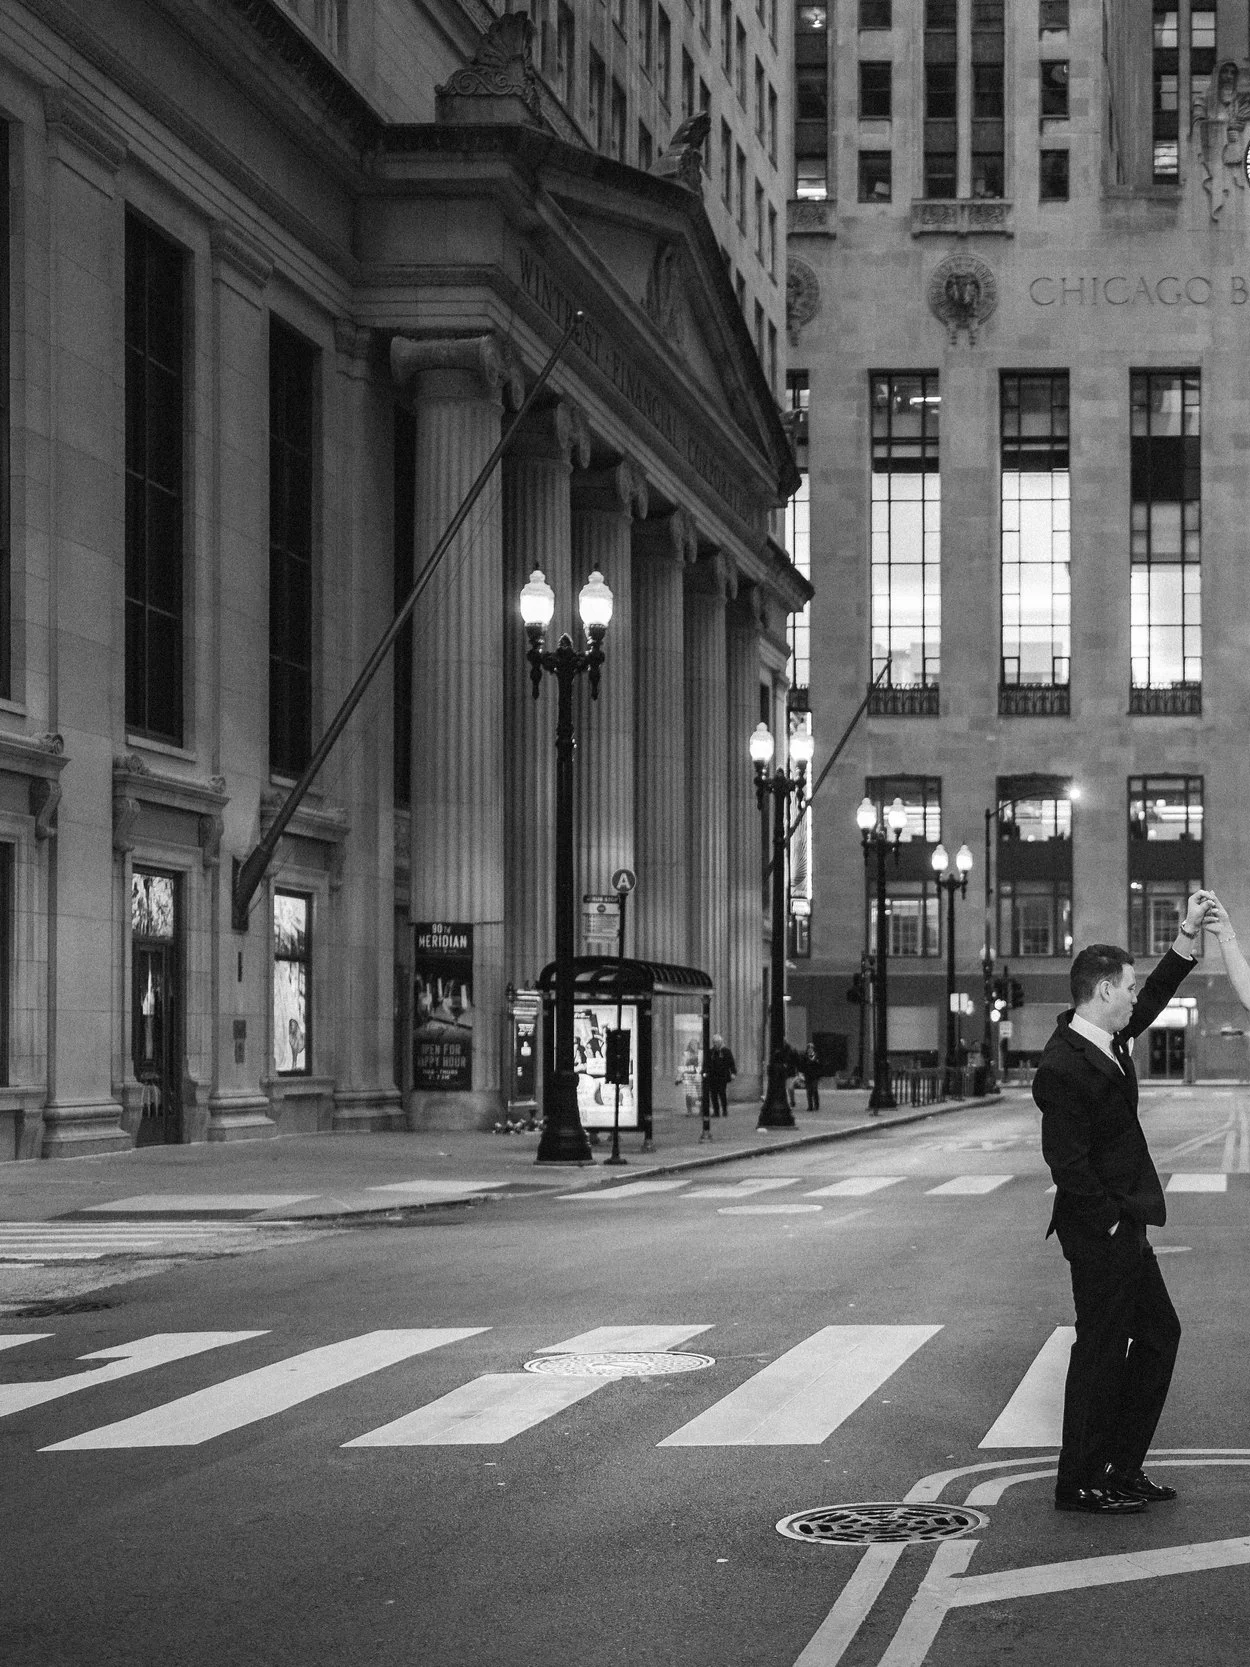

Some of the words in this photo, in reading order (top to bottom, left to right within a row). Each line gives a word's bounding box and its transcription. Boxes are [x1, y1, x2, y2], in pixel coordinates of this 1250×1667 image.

[1029, 276, 1213, 306] CHICAGO
[616, 872, 631, 889] A
[418, 934, 468, 948] MERIDIAN
[421, 1043, 441, 1055] OPEN
[443, 1043, 461, 1055] FOR
[442, 1055, 466, 1068] HOUR
